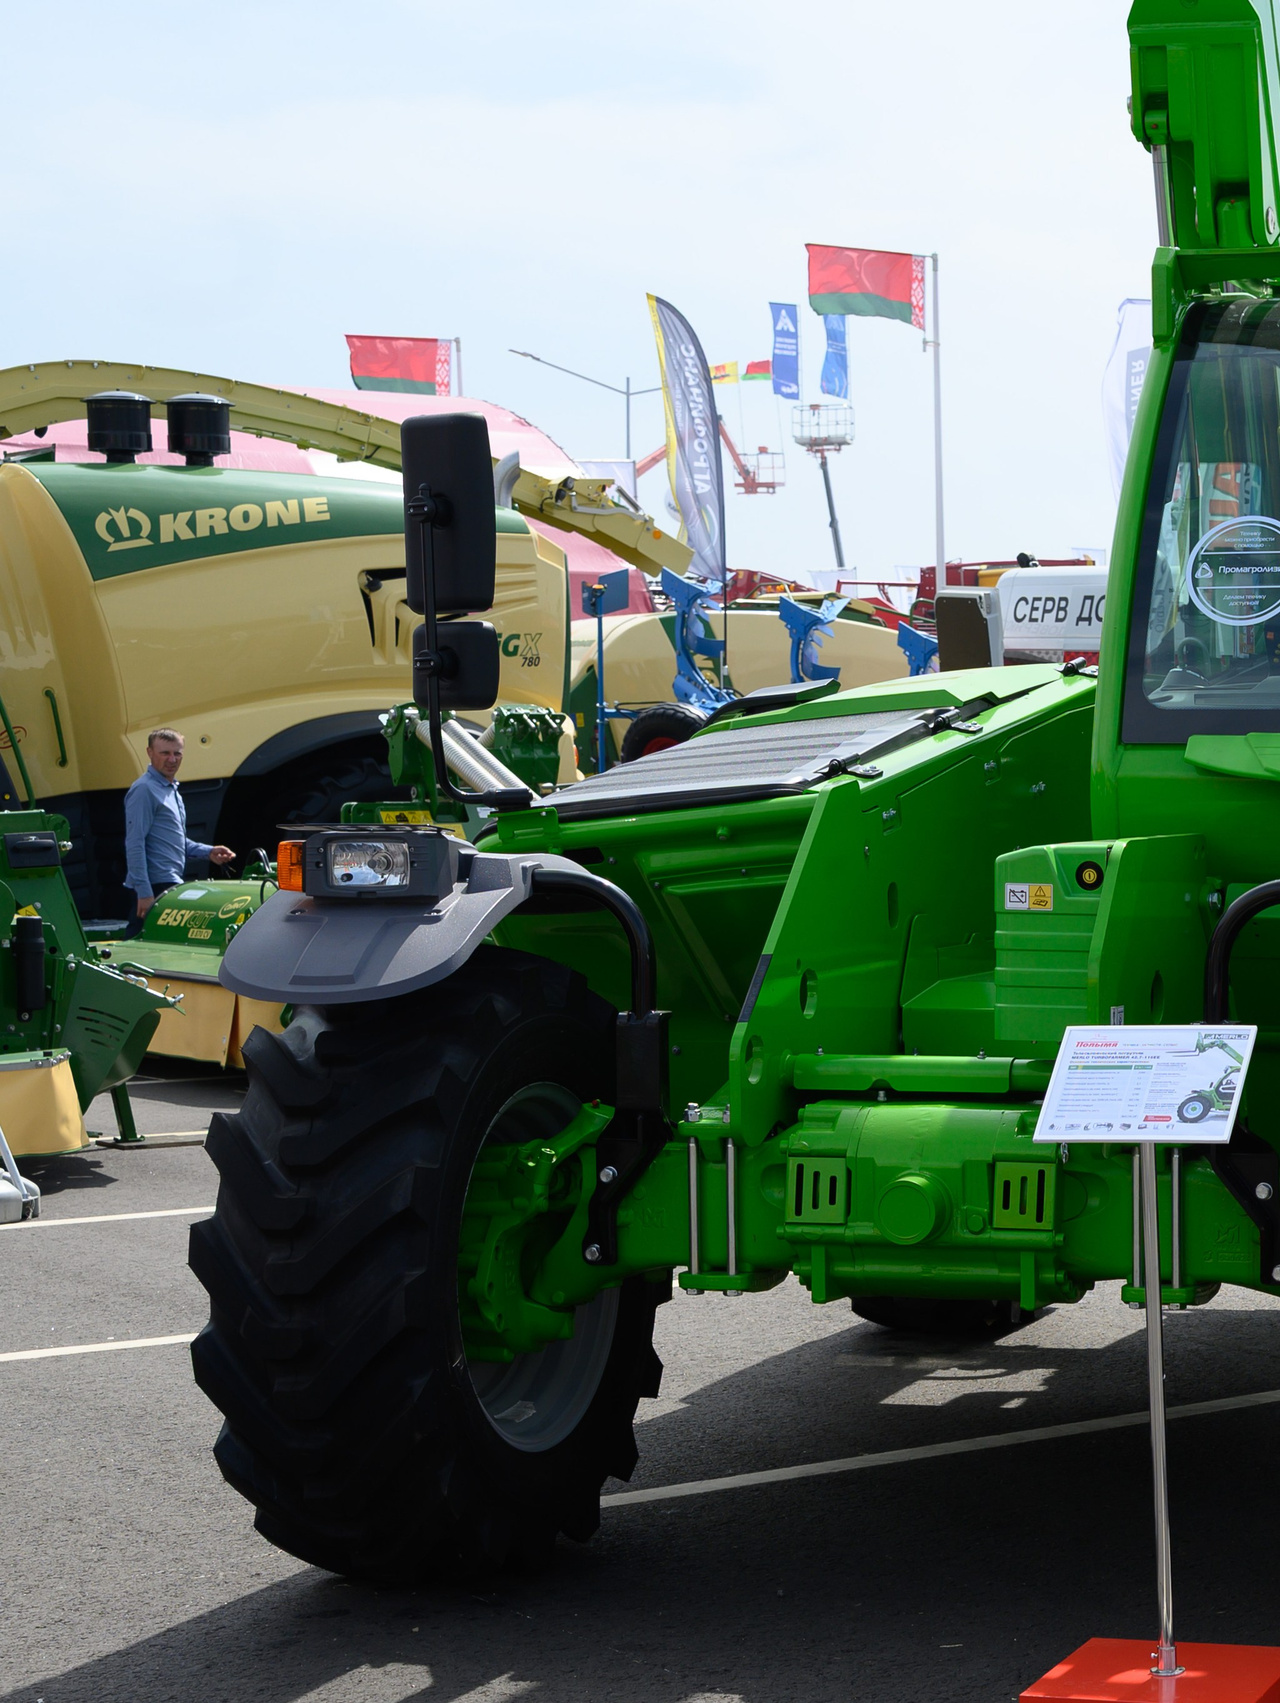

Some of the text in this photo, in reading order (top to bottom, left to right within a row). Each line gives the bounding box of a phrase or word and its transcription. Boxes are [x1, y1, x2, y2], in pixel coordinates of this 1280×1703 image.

[159, 496, 331, 544] KRONE
[1013, 596, 1069, 623] СЕРВ
[521, 657, 541, 668] 780
